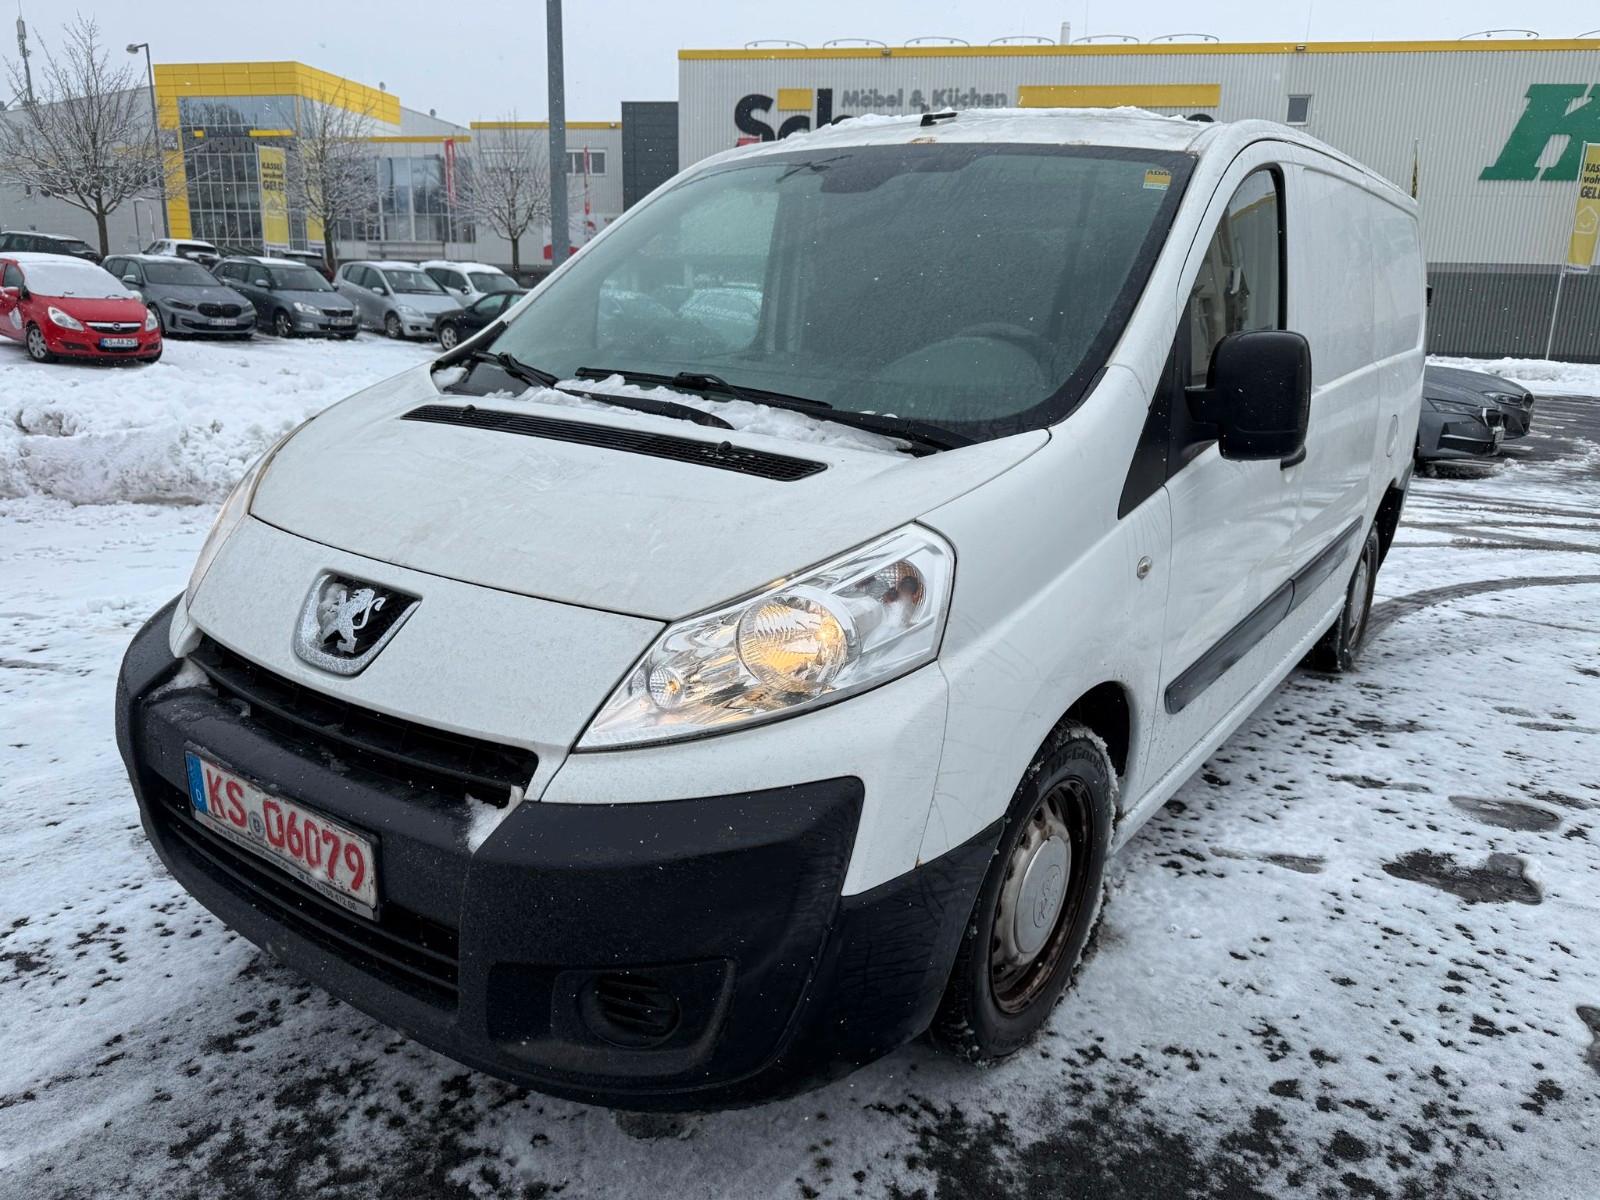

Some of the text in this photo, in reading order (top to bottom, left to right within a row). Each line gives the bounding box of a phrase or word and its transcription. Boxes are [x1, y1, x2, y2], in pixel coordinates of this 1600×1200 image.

[841, 87, 1008, 108] Möbel & Küchen
[206, 768, 247, 828] KS
[263, 799, 366, 891] 06079
